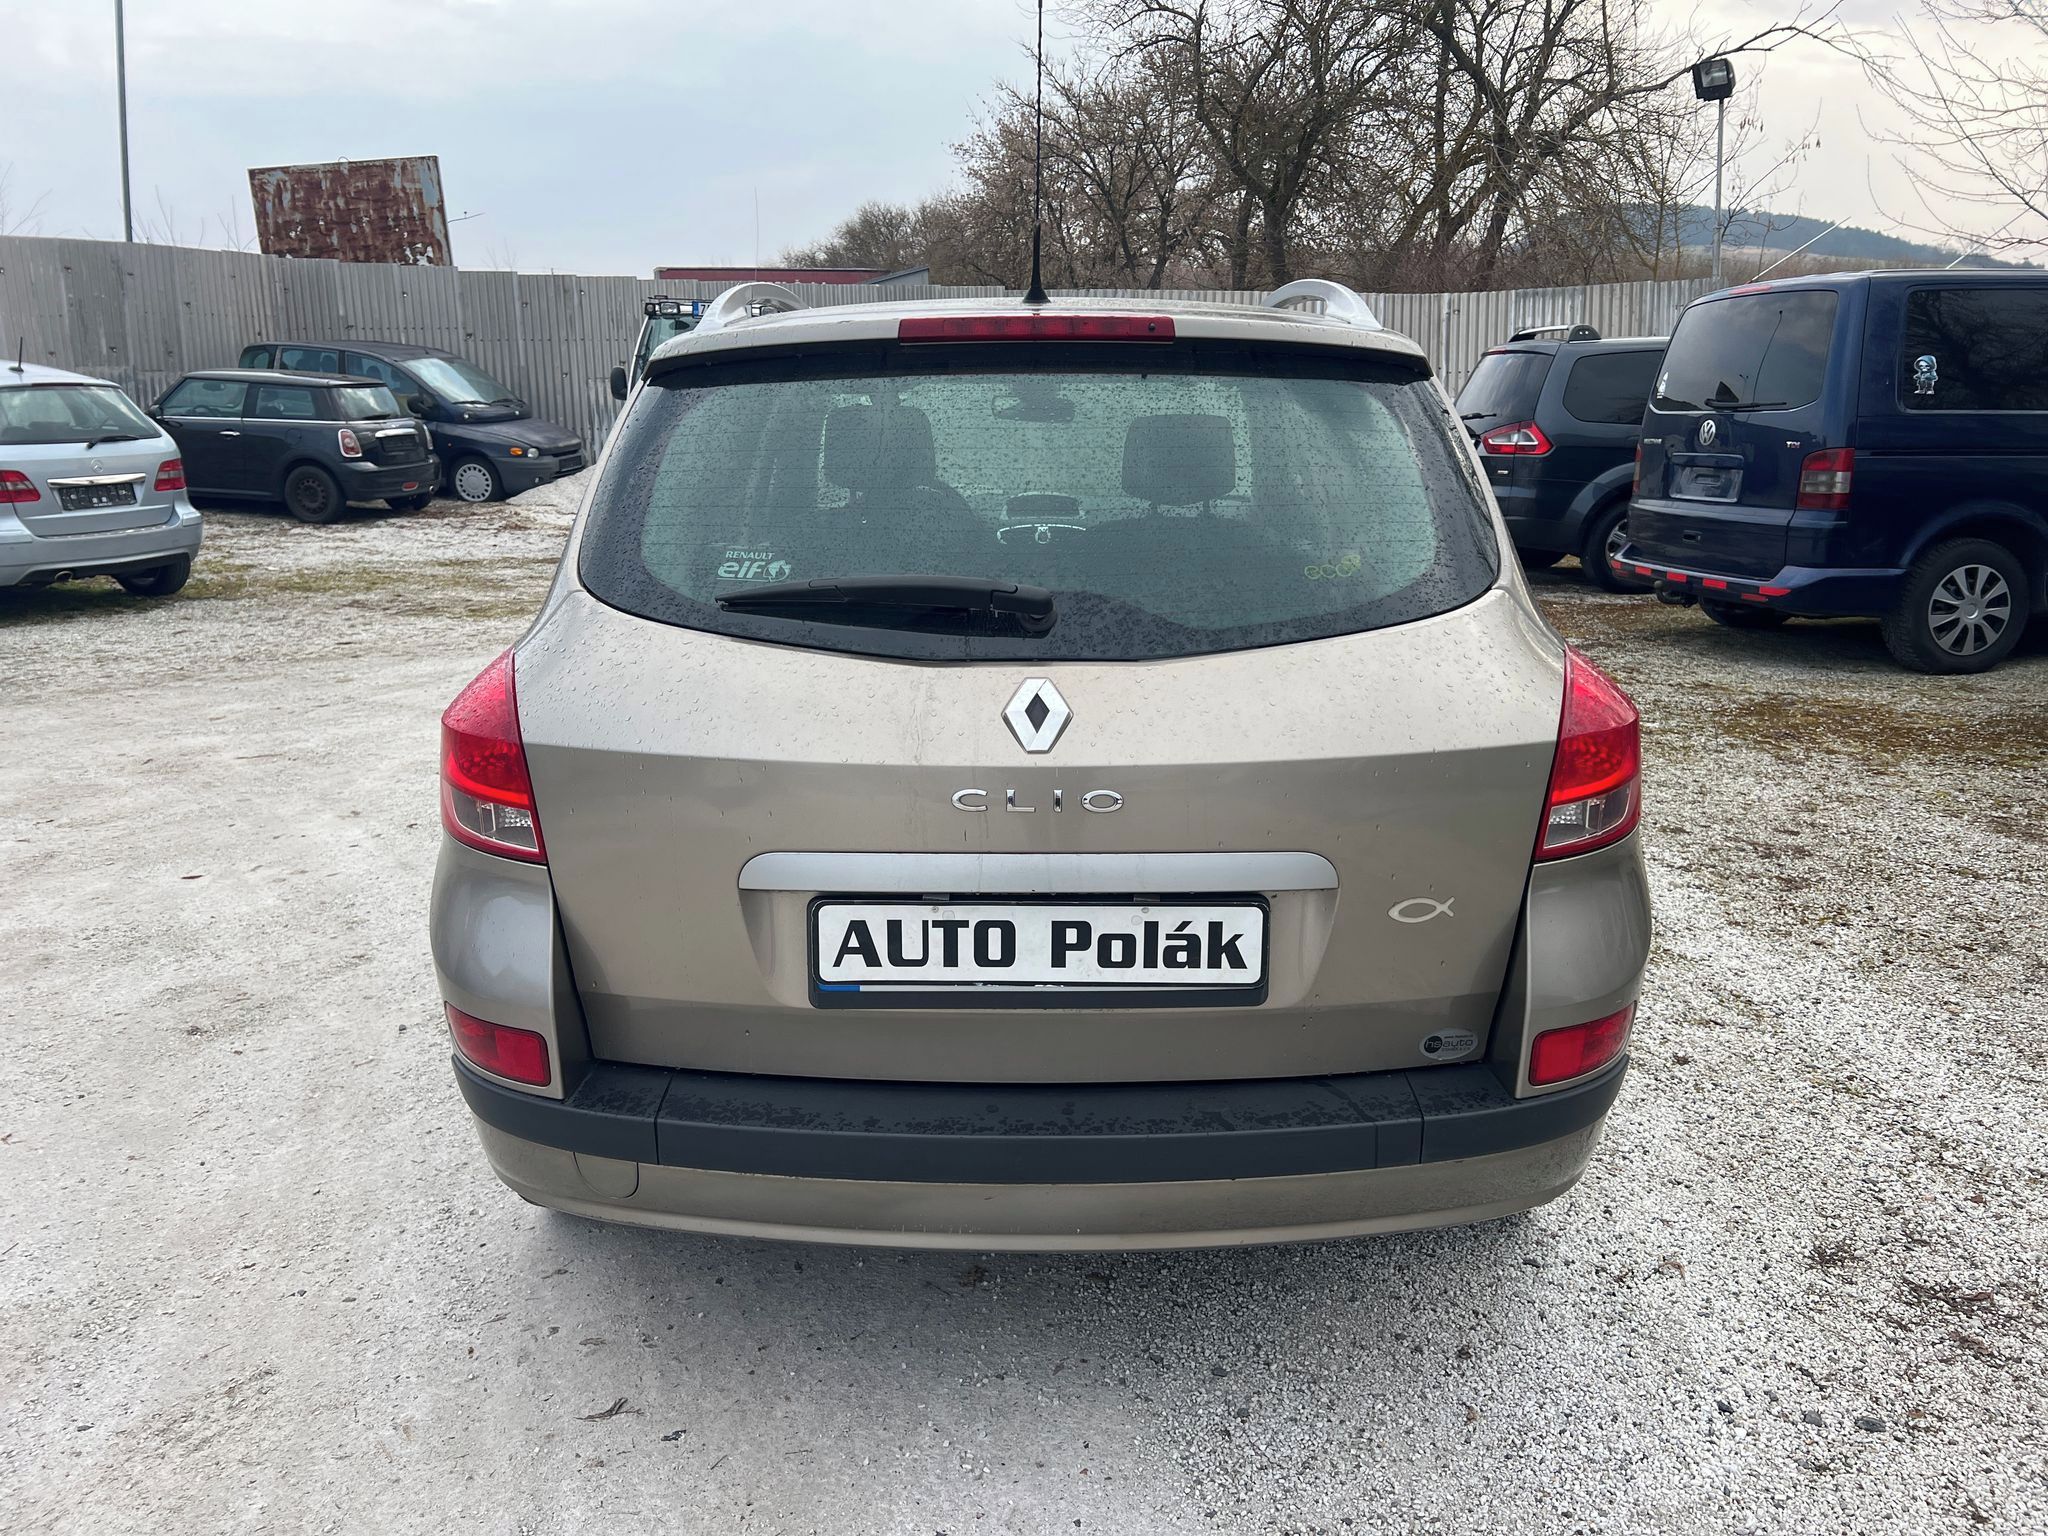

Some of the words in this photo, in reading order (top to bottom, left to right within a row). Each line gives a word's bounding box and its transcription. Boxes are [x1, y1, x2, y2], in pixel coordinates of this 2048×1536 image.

[725, 550, 775, 560] RENAULT
[717, 560, 766, 579] elf
[951, 788, 1125, 813] CLIO
[832, 919, 1017, 968] AUTO
[1050, 920, 1248, 970] Polák
